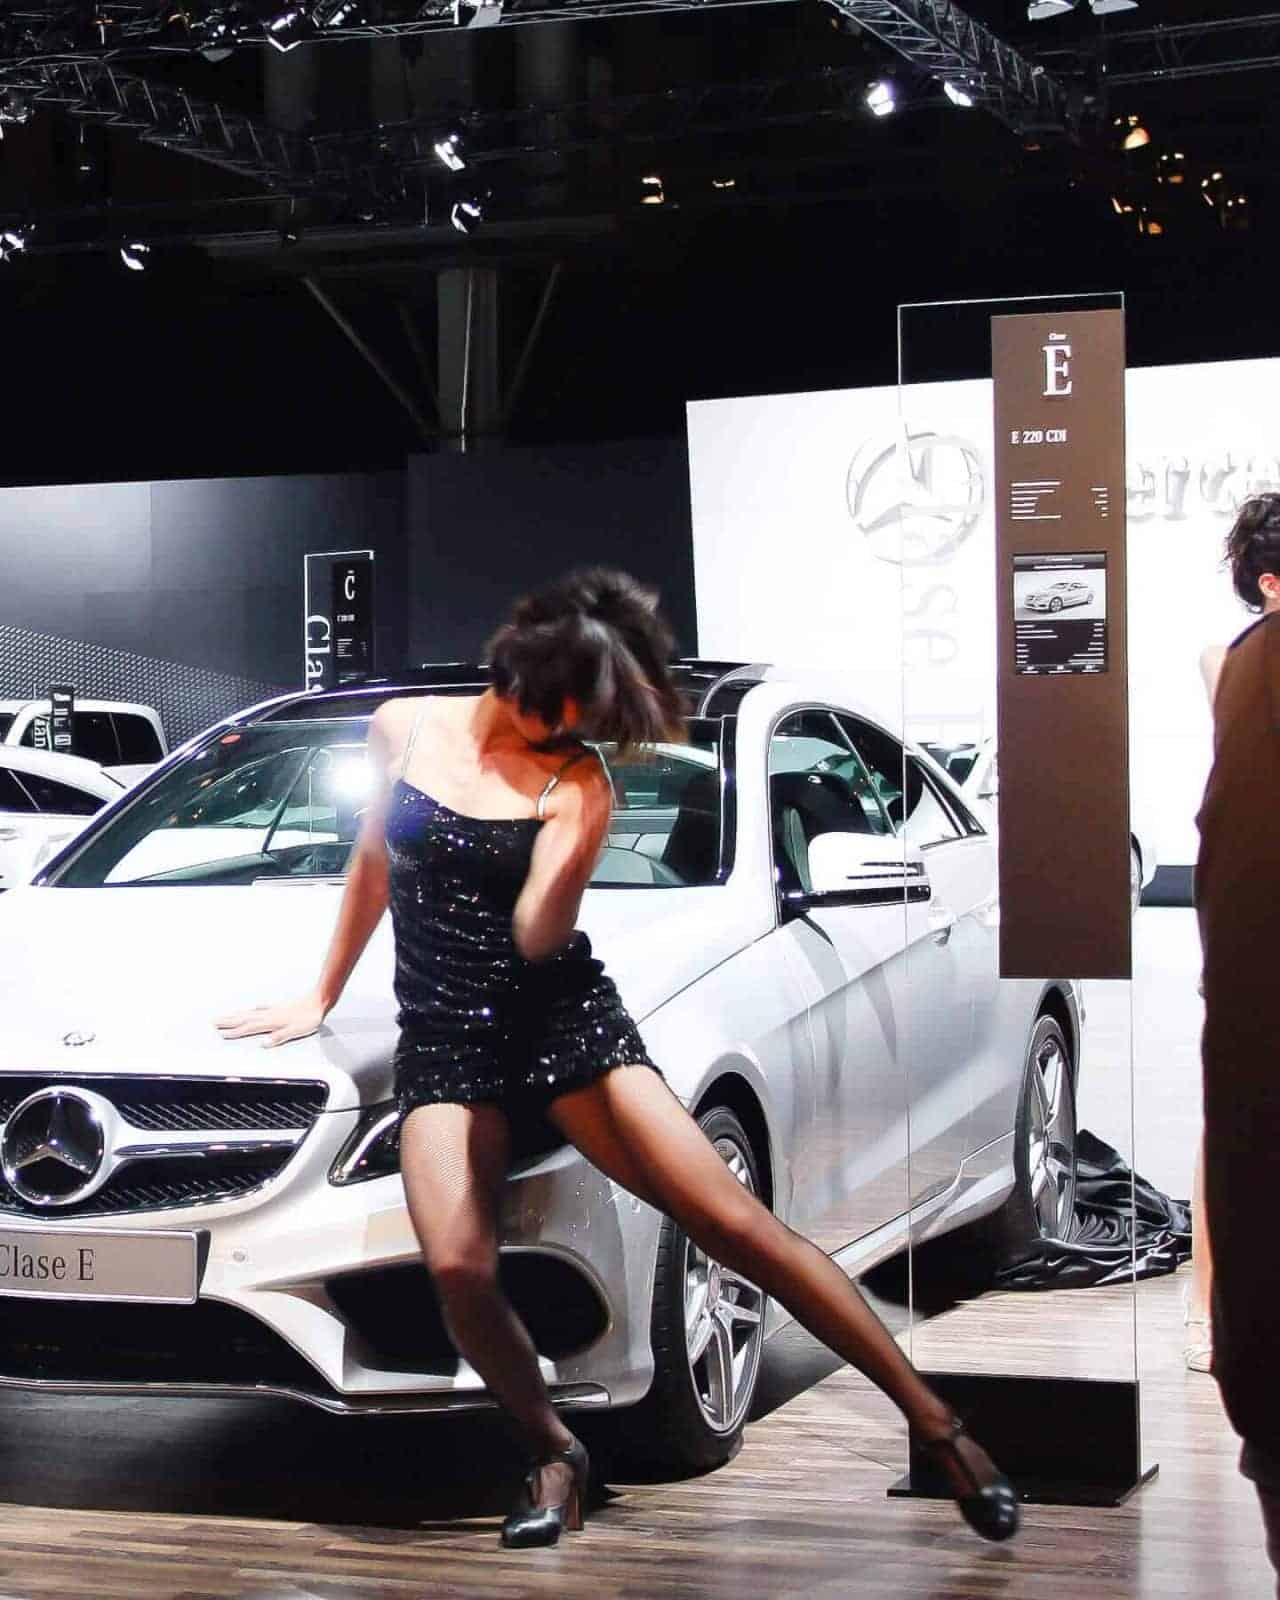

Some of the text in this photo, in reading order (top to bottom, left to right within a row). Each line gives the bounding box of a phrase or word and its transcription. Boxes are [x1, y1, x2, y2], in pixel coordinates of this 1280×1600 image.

[1042, 344, 1072, 396] E
[1022, 430, 1043, 444] 220
[1045, 428, 1068, 443] CDI
[344, 574, 356, 601] C
[78, 1247, 97, 1281] E
